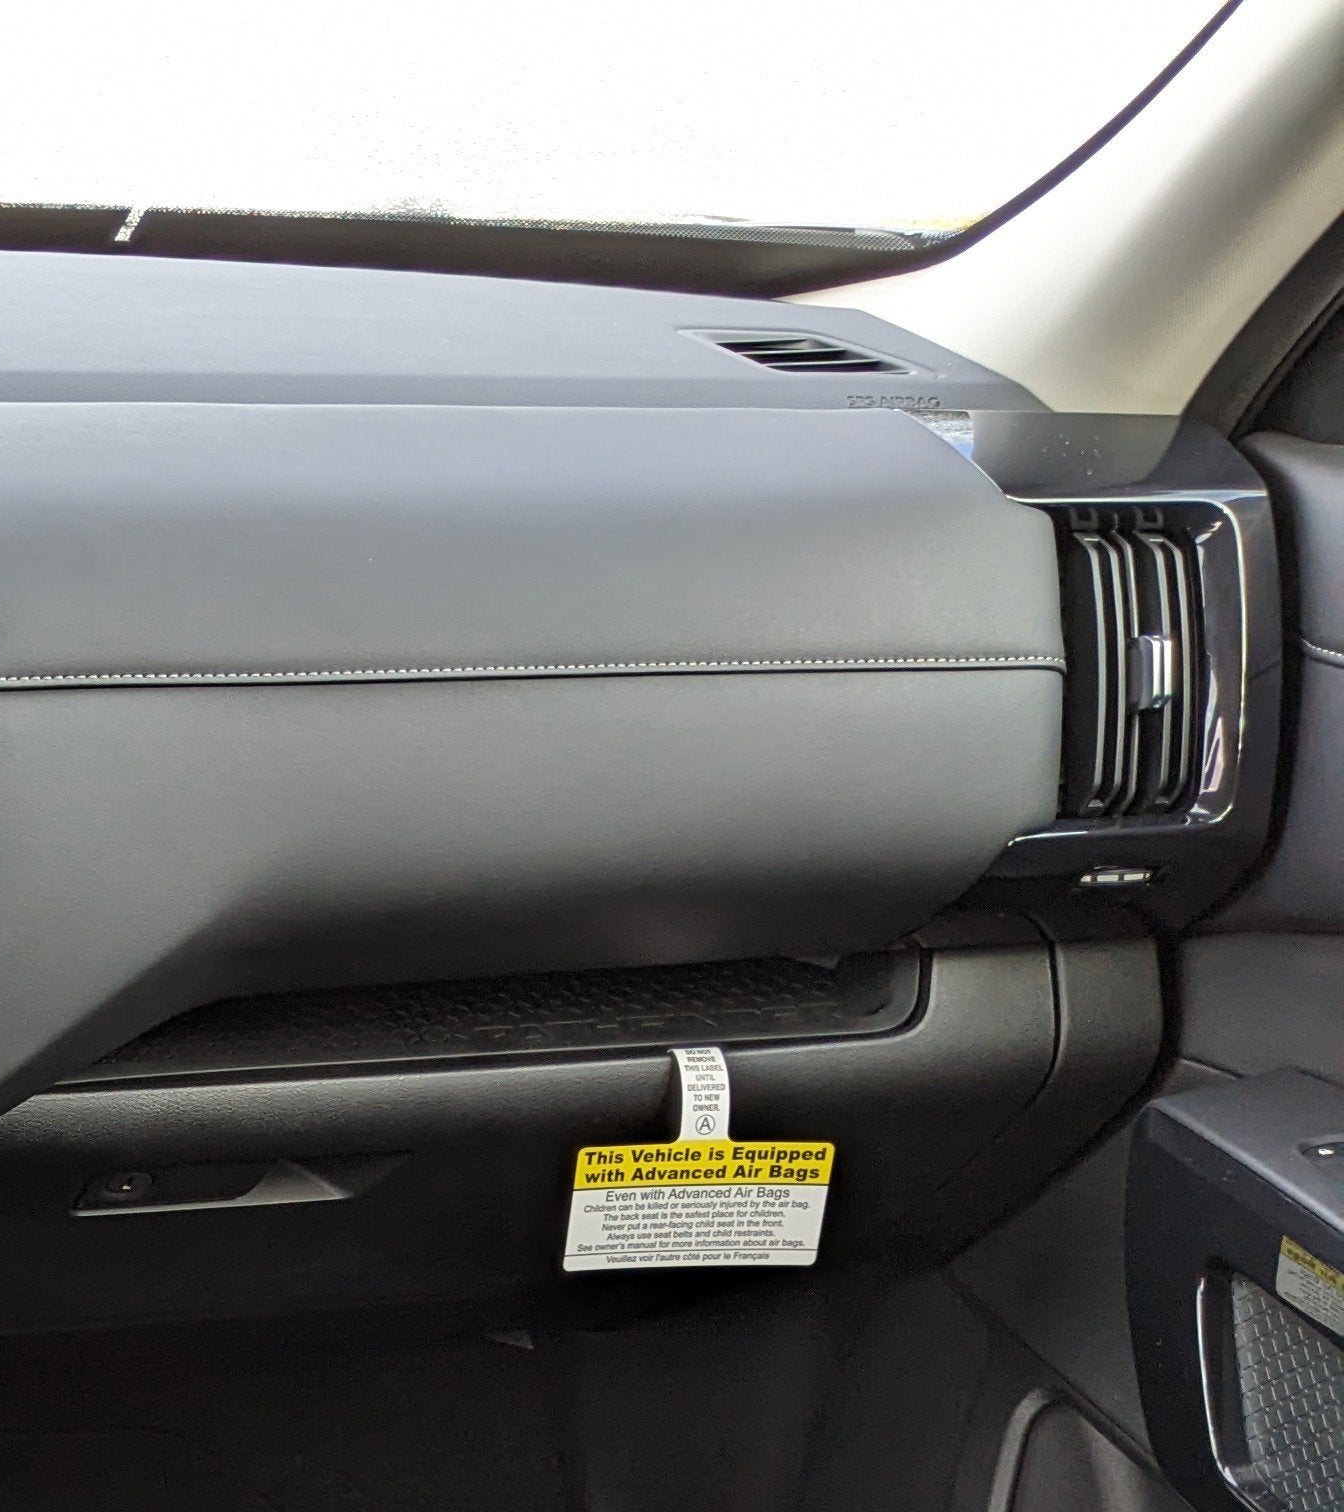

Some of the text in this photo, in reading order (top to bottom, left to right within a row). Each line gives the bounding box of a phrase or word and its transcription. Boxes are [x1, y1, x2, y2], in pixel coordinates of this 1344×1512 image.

[585, 1147, 827, 1165] This Vehicle is Equipped
[585, 1165, 820, 1183] with Advanced Air Bags
[606, 1187, 790, 1202] Even with Advanced Air Bags
[584, 1205, 617, 1213] Children
[647, 1202, 668, 1210] killed
[681, 1201, 717, 1209] seriously
[719, 1201, 748, 1209] injured
[750, 1200, 760, 1208] by
[792, 1200, 810, 1209] bag.
[712, 1210, 734, 1218] place
[627, 1223, 640, 1232] put
[650, 1221, 693, 1229] rear-facing
[607, 1233, 635, 1241] Always
[577, 1244, 593, 1252] See
[595, 1242, 624, 1251] owner's
[782, 1239, 805, 1248] bags.
[703, 1253, 721, 1261] pour
[733, 1252, 769, 1261] Français
